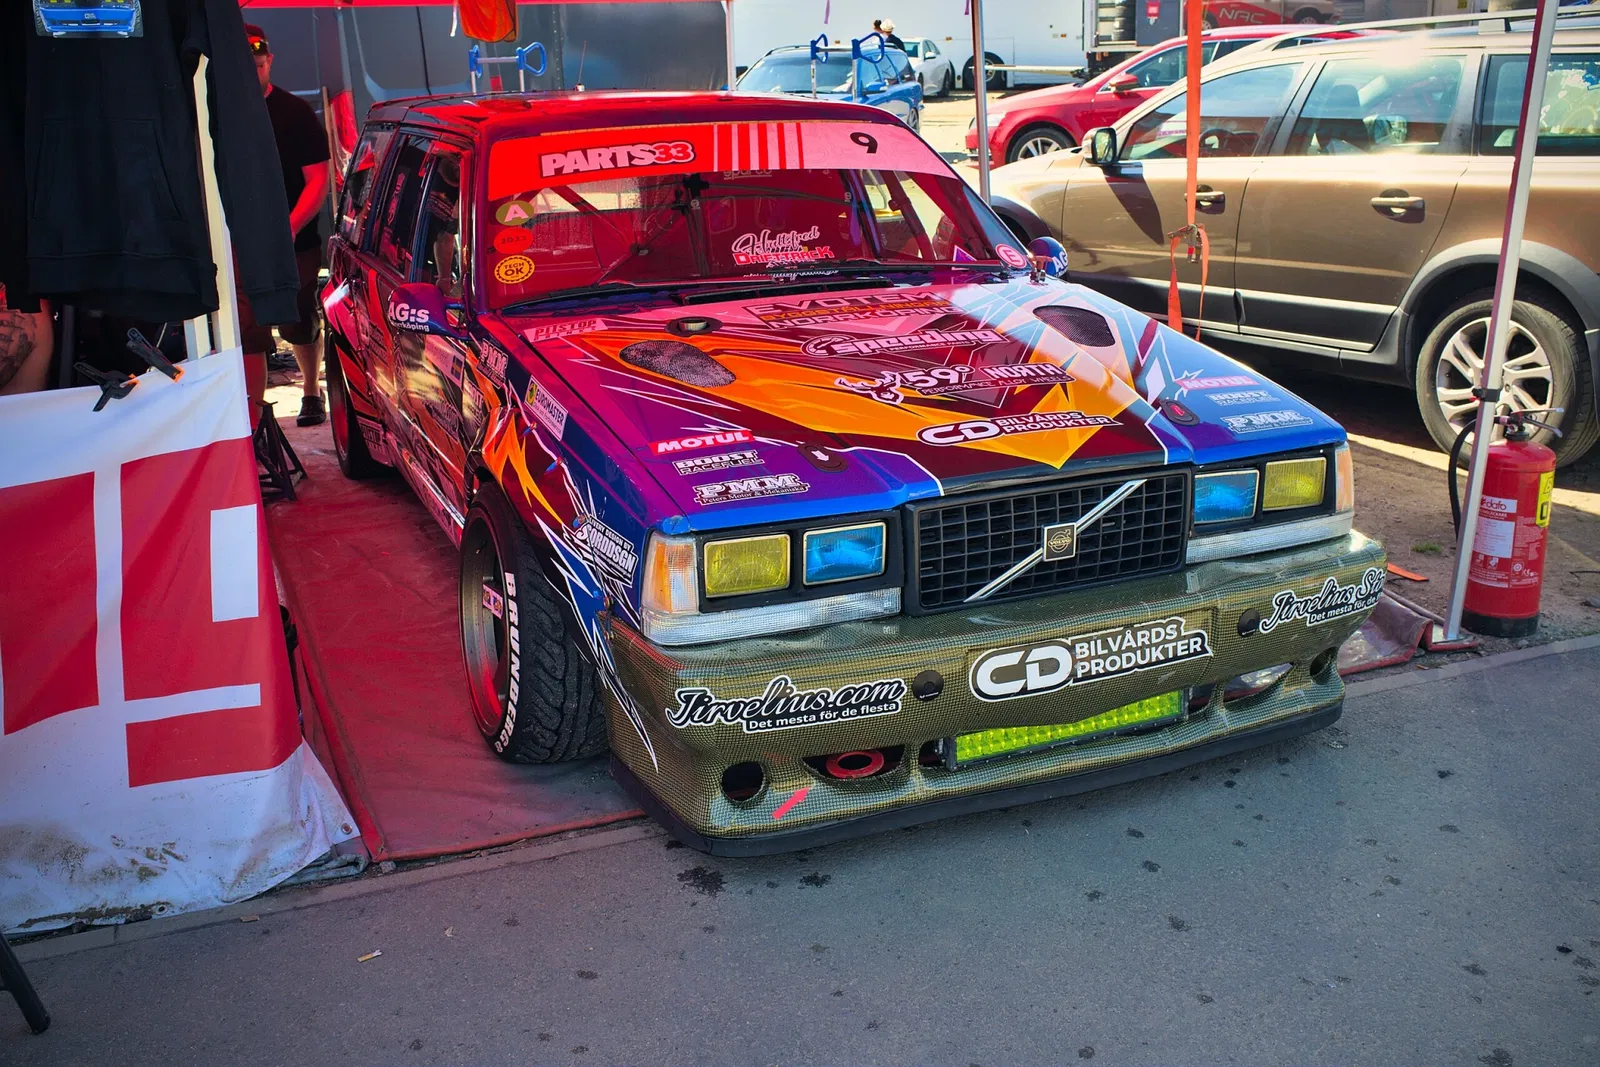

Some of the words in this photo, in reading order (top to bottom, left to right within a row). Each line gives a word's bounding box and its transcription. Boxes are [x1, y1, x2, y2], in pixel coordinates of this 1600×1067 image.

[1220, 8, 1266, 24] NAC
[850, 132, 879, 155] 9
[541, 141, 696, 178] PARTS33
[504, 203, 530, 223] A
[504, 262, 525, 270] TECH
[1002, 249, 1021, 263] E
[504, 267, 525, 277] OK
[833, 330, 1003, 354] speeding
[921, 380, 992, 395] PERFORMANCE
[1184, 376, 1255, 390] MOTUL
[536, 388, 564, 426] EUROMASTER
[922, 421, 1001, 445] CD
[995, 411, 1083, 427] BILVÅRDS
[1003, 416, 1112, 433] PRODUKTER
[1226, 410, 1302, 428] PMM
[657, 432, 750, 453] MOTUL
[675, 450, 758, 468] BOOST
[680, 457, 765, 475] RACEFUEL
[697, 474, 800, 498] PMM
[703, 494, 727, 504] Peters
[729, 491, 752, 500] Motor
[764, 486, 805, 496] Mekaniska
[1486, 499, 1506, 510] dafo
[590, 517, 606, 533] LIVERY
[605, 529, 623, 546] DESIGN
[623, 543, 632, 551] BY
[1048, 537, 1072, 548] VOLVO
[1261, 578, 1355, 631] Jirvelius
[1311, 612, 1326, 623] Det
[1327, 603, 1353, 618] mesta
[1354, 600, 1366, 610] för
[1366, 596, 1376, 606] de
[976, 645, 1073, 696] CD
[1075, 623, 1179, 660] BILVÅRDS
[1076, 637, 1203, 678] PRODUKTER
[666, 676, 904, 727] Jirvelius.com
[749, 720, 773, 730] Det
[776, 714, 817, 726] mesta
[819, 711, 839, 721] för
[841, 708, 858, 717] de
[861, 702, 897, 714] flesta
